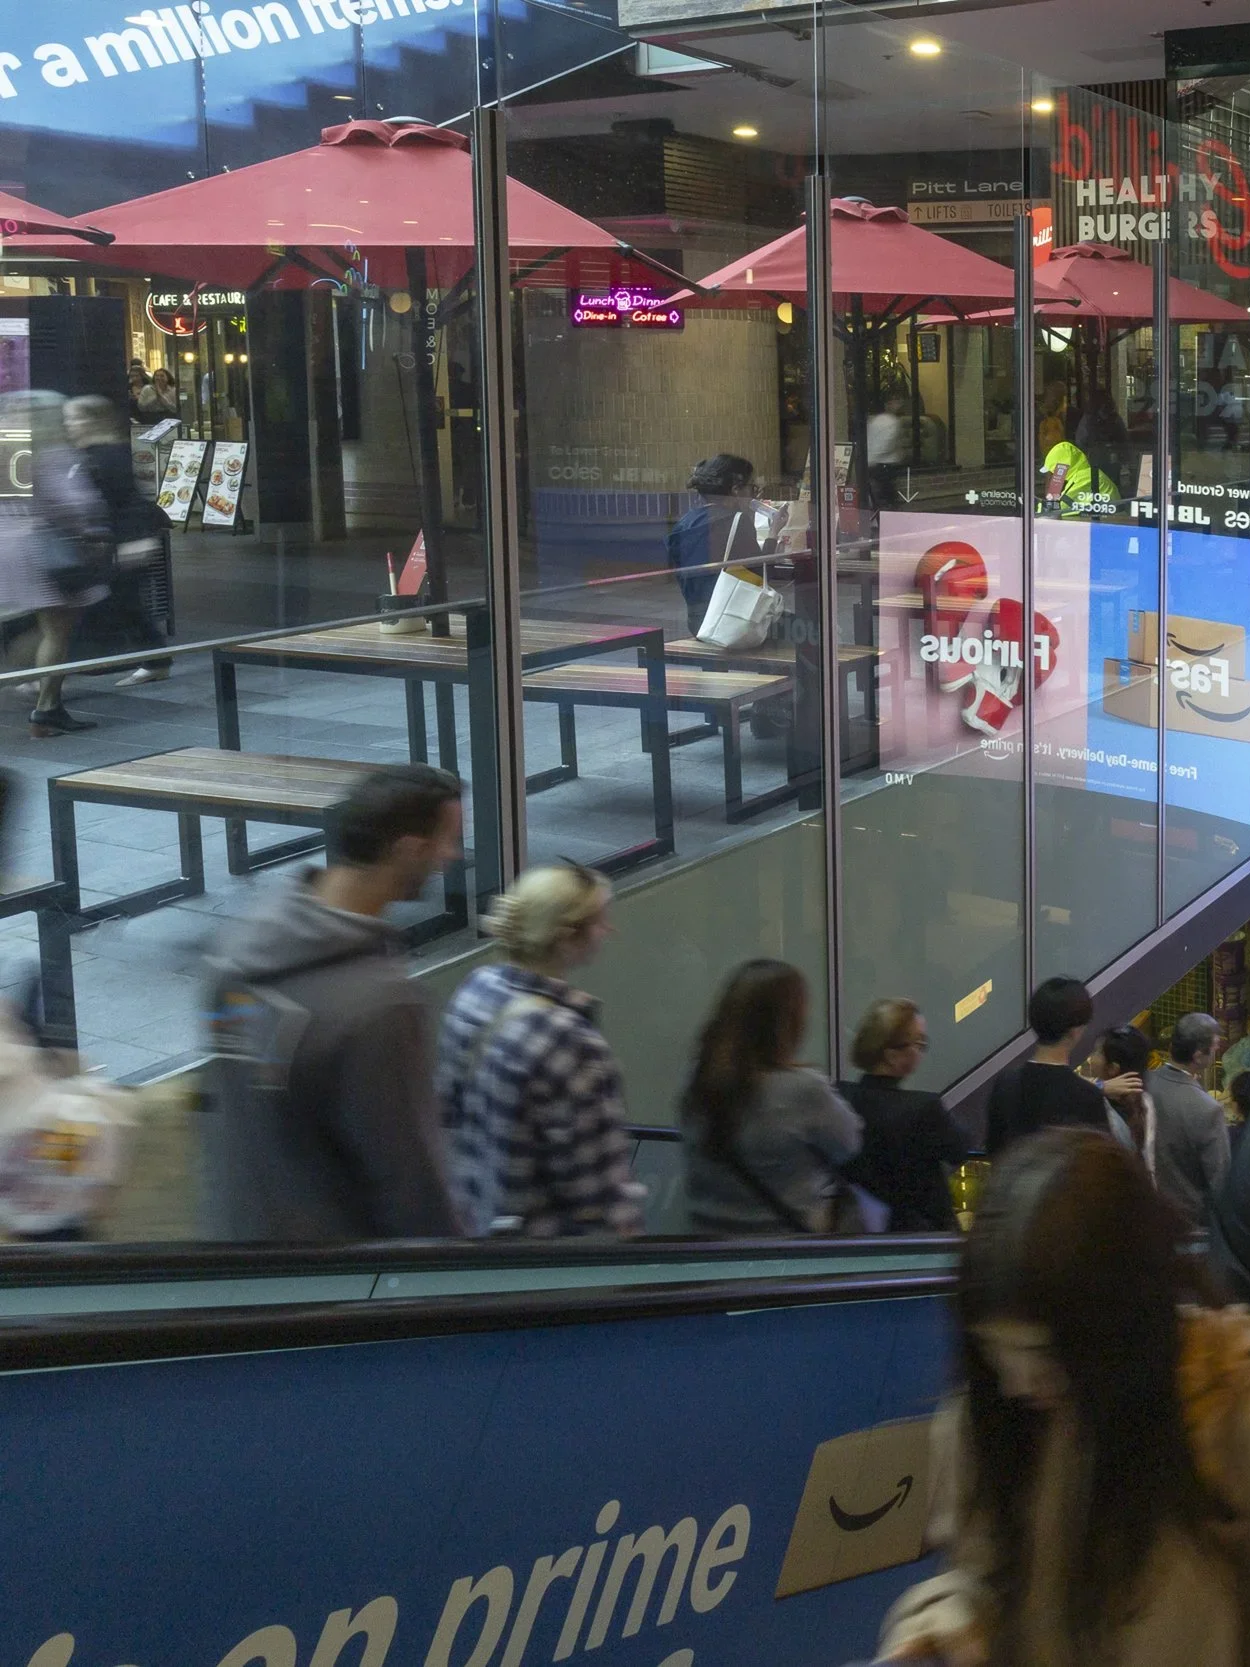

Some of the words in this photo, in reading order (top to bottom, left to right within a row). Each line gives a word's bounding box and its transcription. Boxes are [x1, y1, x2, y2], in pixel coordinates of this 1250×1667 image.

[33, 42, 89, 88] a
[84, 0, 301, 78] million
[297, 0, 464, 35] ite.
[912, 181, 957, 195] Pitt
[964, 180, 1023, 193] Lane
[1076, 173, 1222, 207] HEALTHY
[926, 205, 957, 220] LIFTS
[152, 294, 178, 306] CAFE
[183, 293, 191, 306] &
[580, 295, 615, 306] Lunch
[583, 311, 617, 320] Dine-in
[422, 1499, 752, 1667] prime
